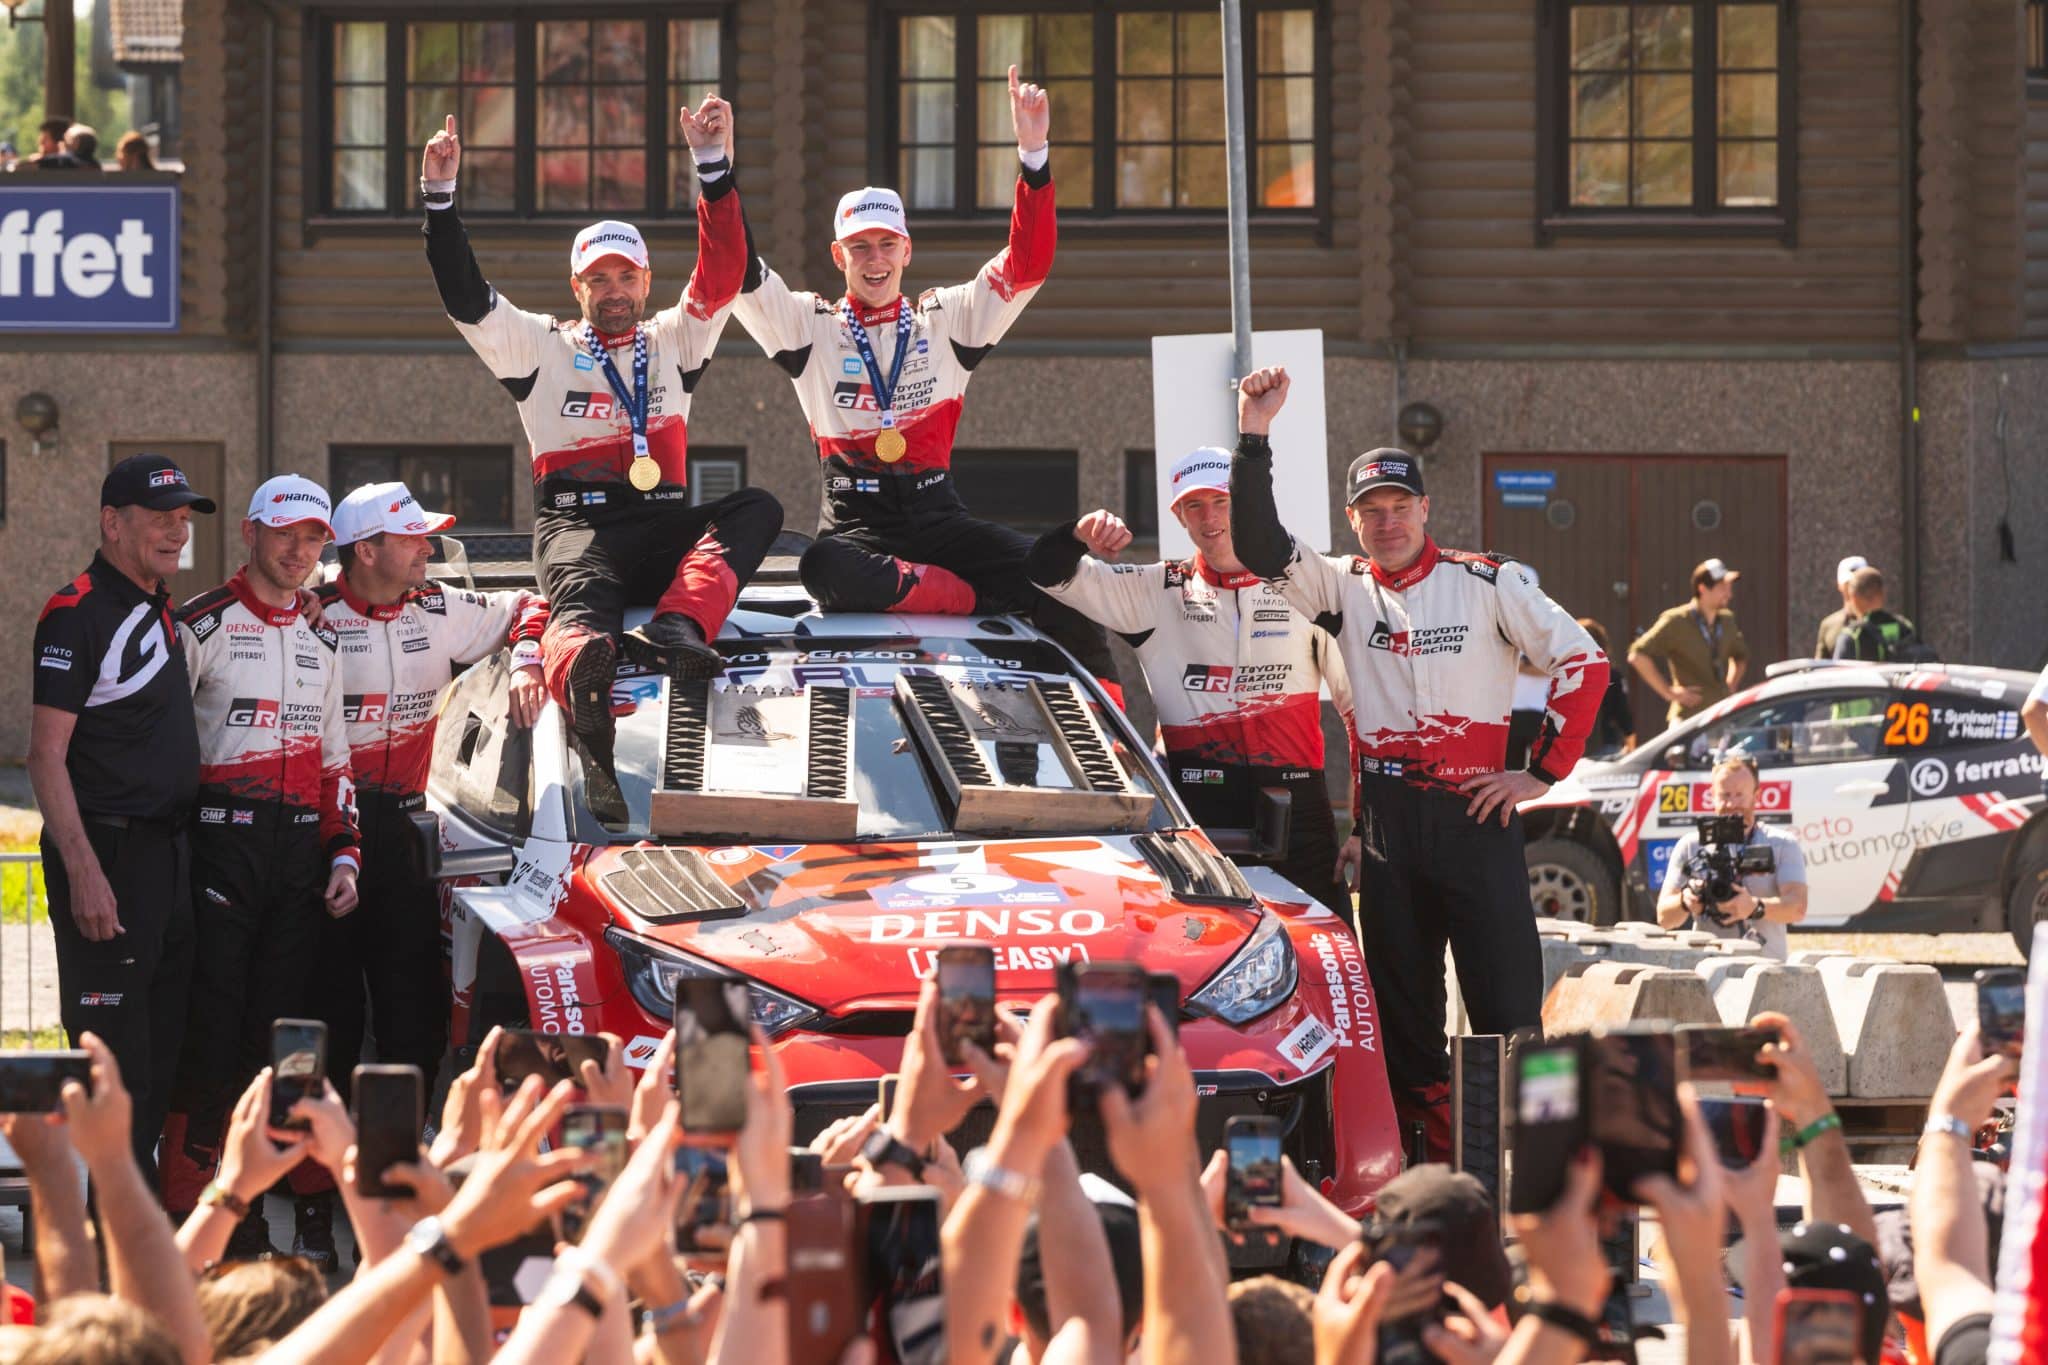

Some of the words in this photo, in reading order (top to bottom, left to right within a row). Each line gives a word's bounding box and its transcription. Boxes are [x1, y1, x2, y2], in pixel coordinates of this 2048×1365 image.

[834, 392, 877, 411] GR
[562, 401, 612, 419] GR
[151, 472, 174, 485] GR
[555, 494, 577, 505] OMP
[194, 616, 216, 635] OMP
[226, 623, 265, 634] DENSO
[1412, 625, 1469, 638] TOYOTA
[1411, 635, 1464, 647] GAZOO
[1410, 644, 1462, 657] Racing
[1239, 664, 1292, 673] TOYOTA
[1184, 675, 1228, 692] GR
[1235, 673, 1286, 683] GAZOO
[1234, 682, 1284, 693] Racing
[395, 690, 437, 703] TOYOTA
[392, 700, 432, 712] GAZOO
[228, 709, 277, 728] GR
[387, 710, 430, 721] Racing
[1932, 708, 1942, 724] T.
[1884, 701, 1930, 746] 26
[1182, 770, 1203, 780] OMP
[1438, 766, 1456, 776] J.M.
[1458, 766, 1496, 776] LATVALA
[1659, 785, 1689, 812] 26
[200, 810, 226, 821] OMP
[869, 908, 1106, 943] DENSO
[1309, 932, 1353, 1048] Panasonic
[1331, 931, 1376, 1052] AUTOMOTIVE
